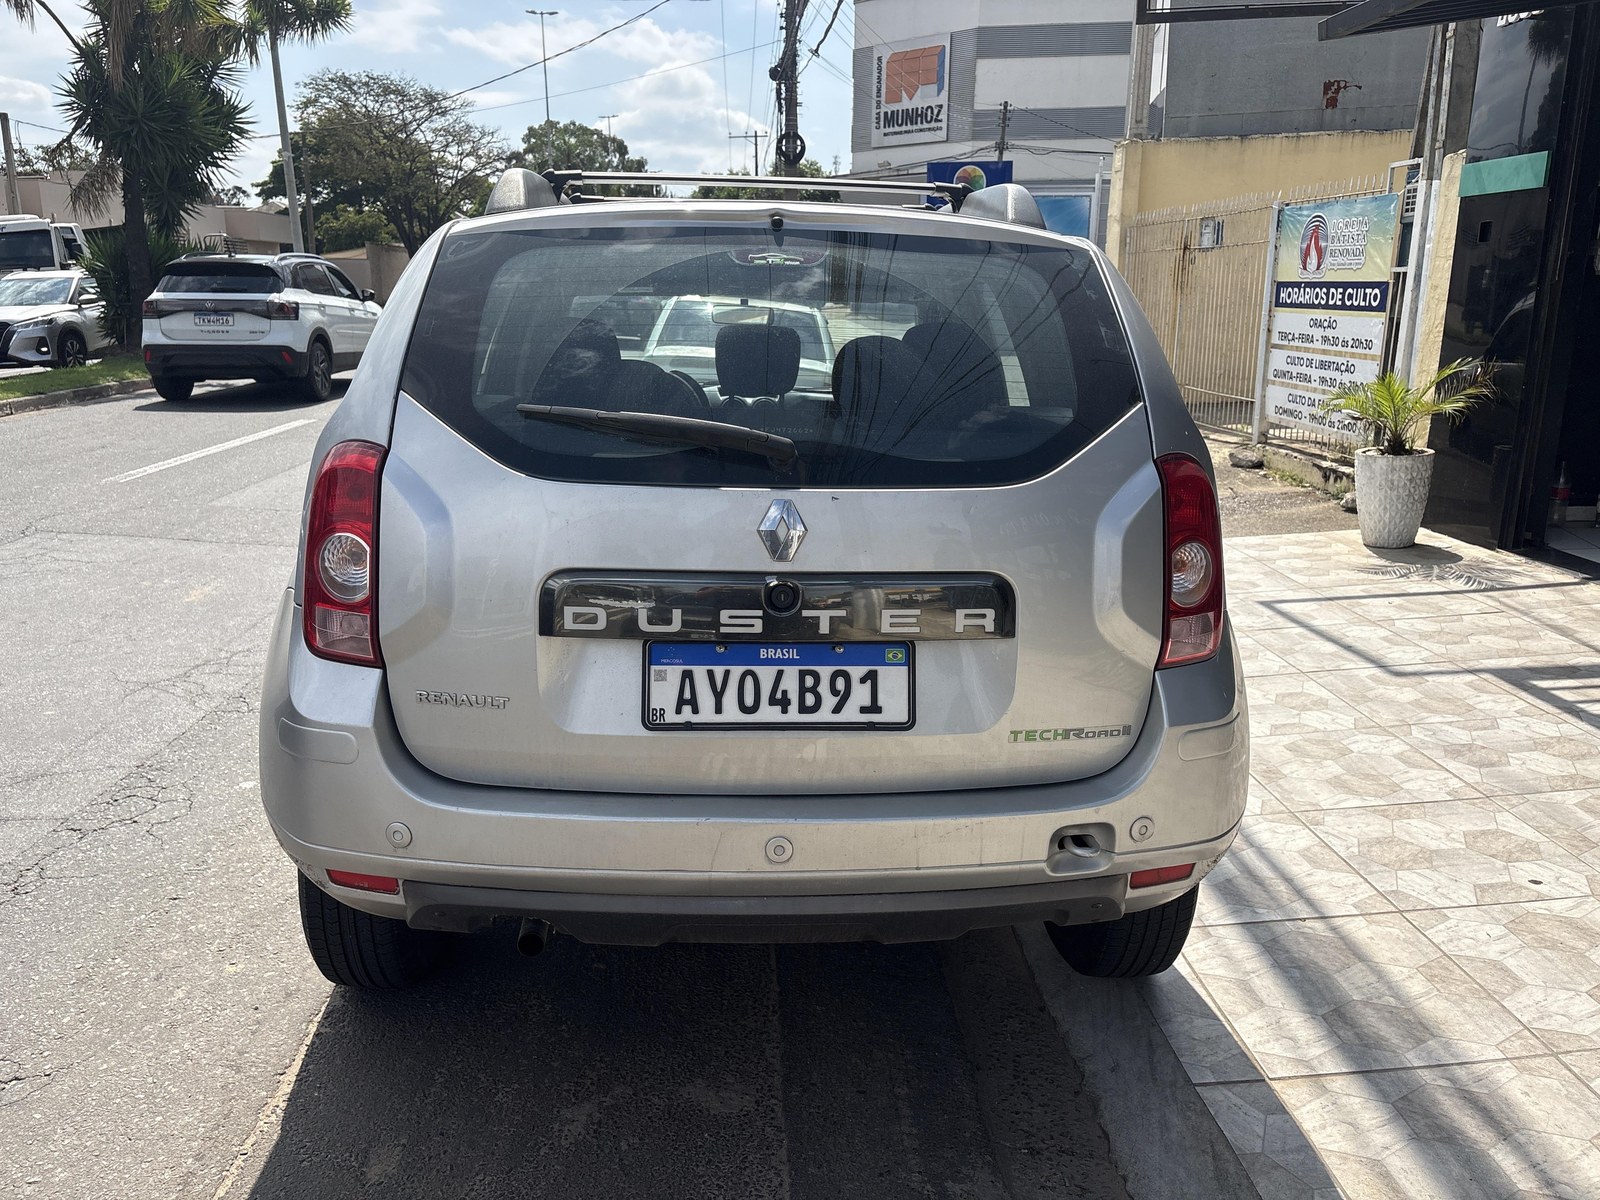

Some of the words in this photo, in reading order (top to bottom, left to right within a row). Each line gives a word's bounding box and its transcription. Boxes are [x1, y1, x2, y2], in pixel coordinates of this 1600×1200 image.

[875, 100, 882, 110] DO
[883, 104, 943, 129] MUNHOZ
[1330, 218, 1369, 232] IGREJA
[1330, 233, 1367, 245] BATISTA
[1329, 246, 1365, 259] RENOVADA
[1280, 283, 1327, 305] HORÁRIOS
[1329, 288, 1343, 305] DE
[1345, 288, 1381, 307] CULTO
[1309, 316, 1338, 332] ORAÇÃO
[1277, 331, 1315, 345] TERÇA-FEIRA
[1320, 335, 1340, 347] 19h30
[1341, 337, 1349, 349] ás
[1350, 338, 1373, 351] 20h30
[1286, 355, 1305, 367] CULTO
[1306, 358, 1314, 369] DE
[1315, 359, 1356, 375] LIBERTAÇÃO
[1272, 368, 1312, 384] QUINTA-FEIRA
[1318, 375, 1337, 389] 19h30
[1287, 392, 1307, 406] CULTO
[1307, 397, 1316, 408] DA
[1274, 405, 1303, 421] DOMINGO
[1308, 413, 1327, 427] 19h00
[1328, 417, 1336, 429] ás
[563, 605, 996, 635] DUSTER
[760, 648, 800, 659] BRASIL
[416, 690, 511, 709] RENAULT
[675, 669, 883, 715] AYO4B91
[651, 707, 666, 723] BR
